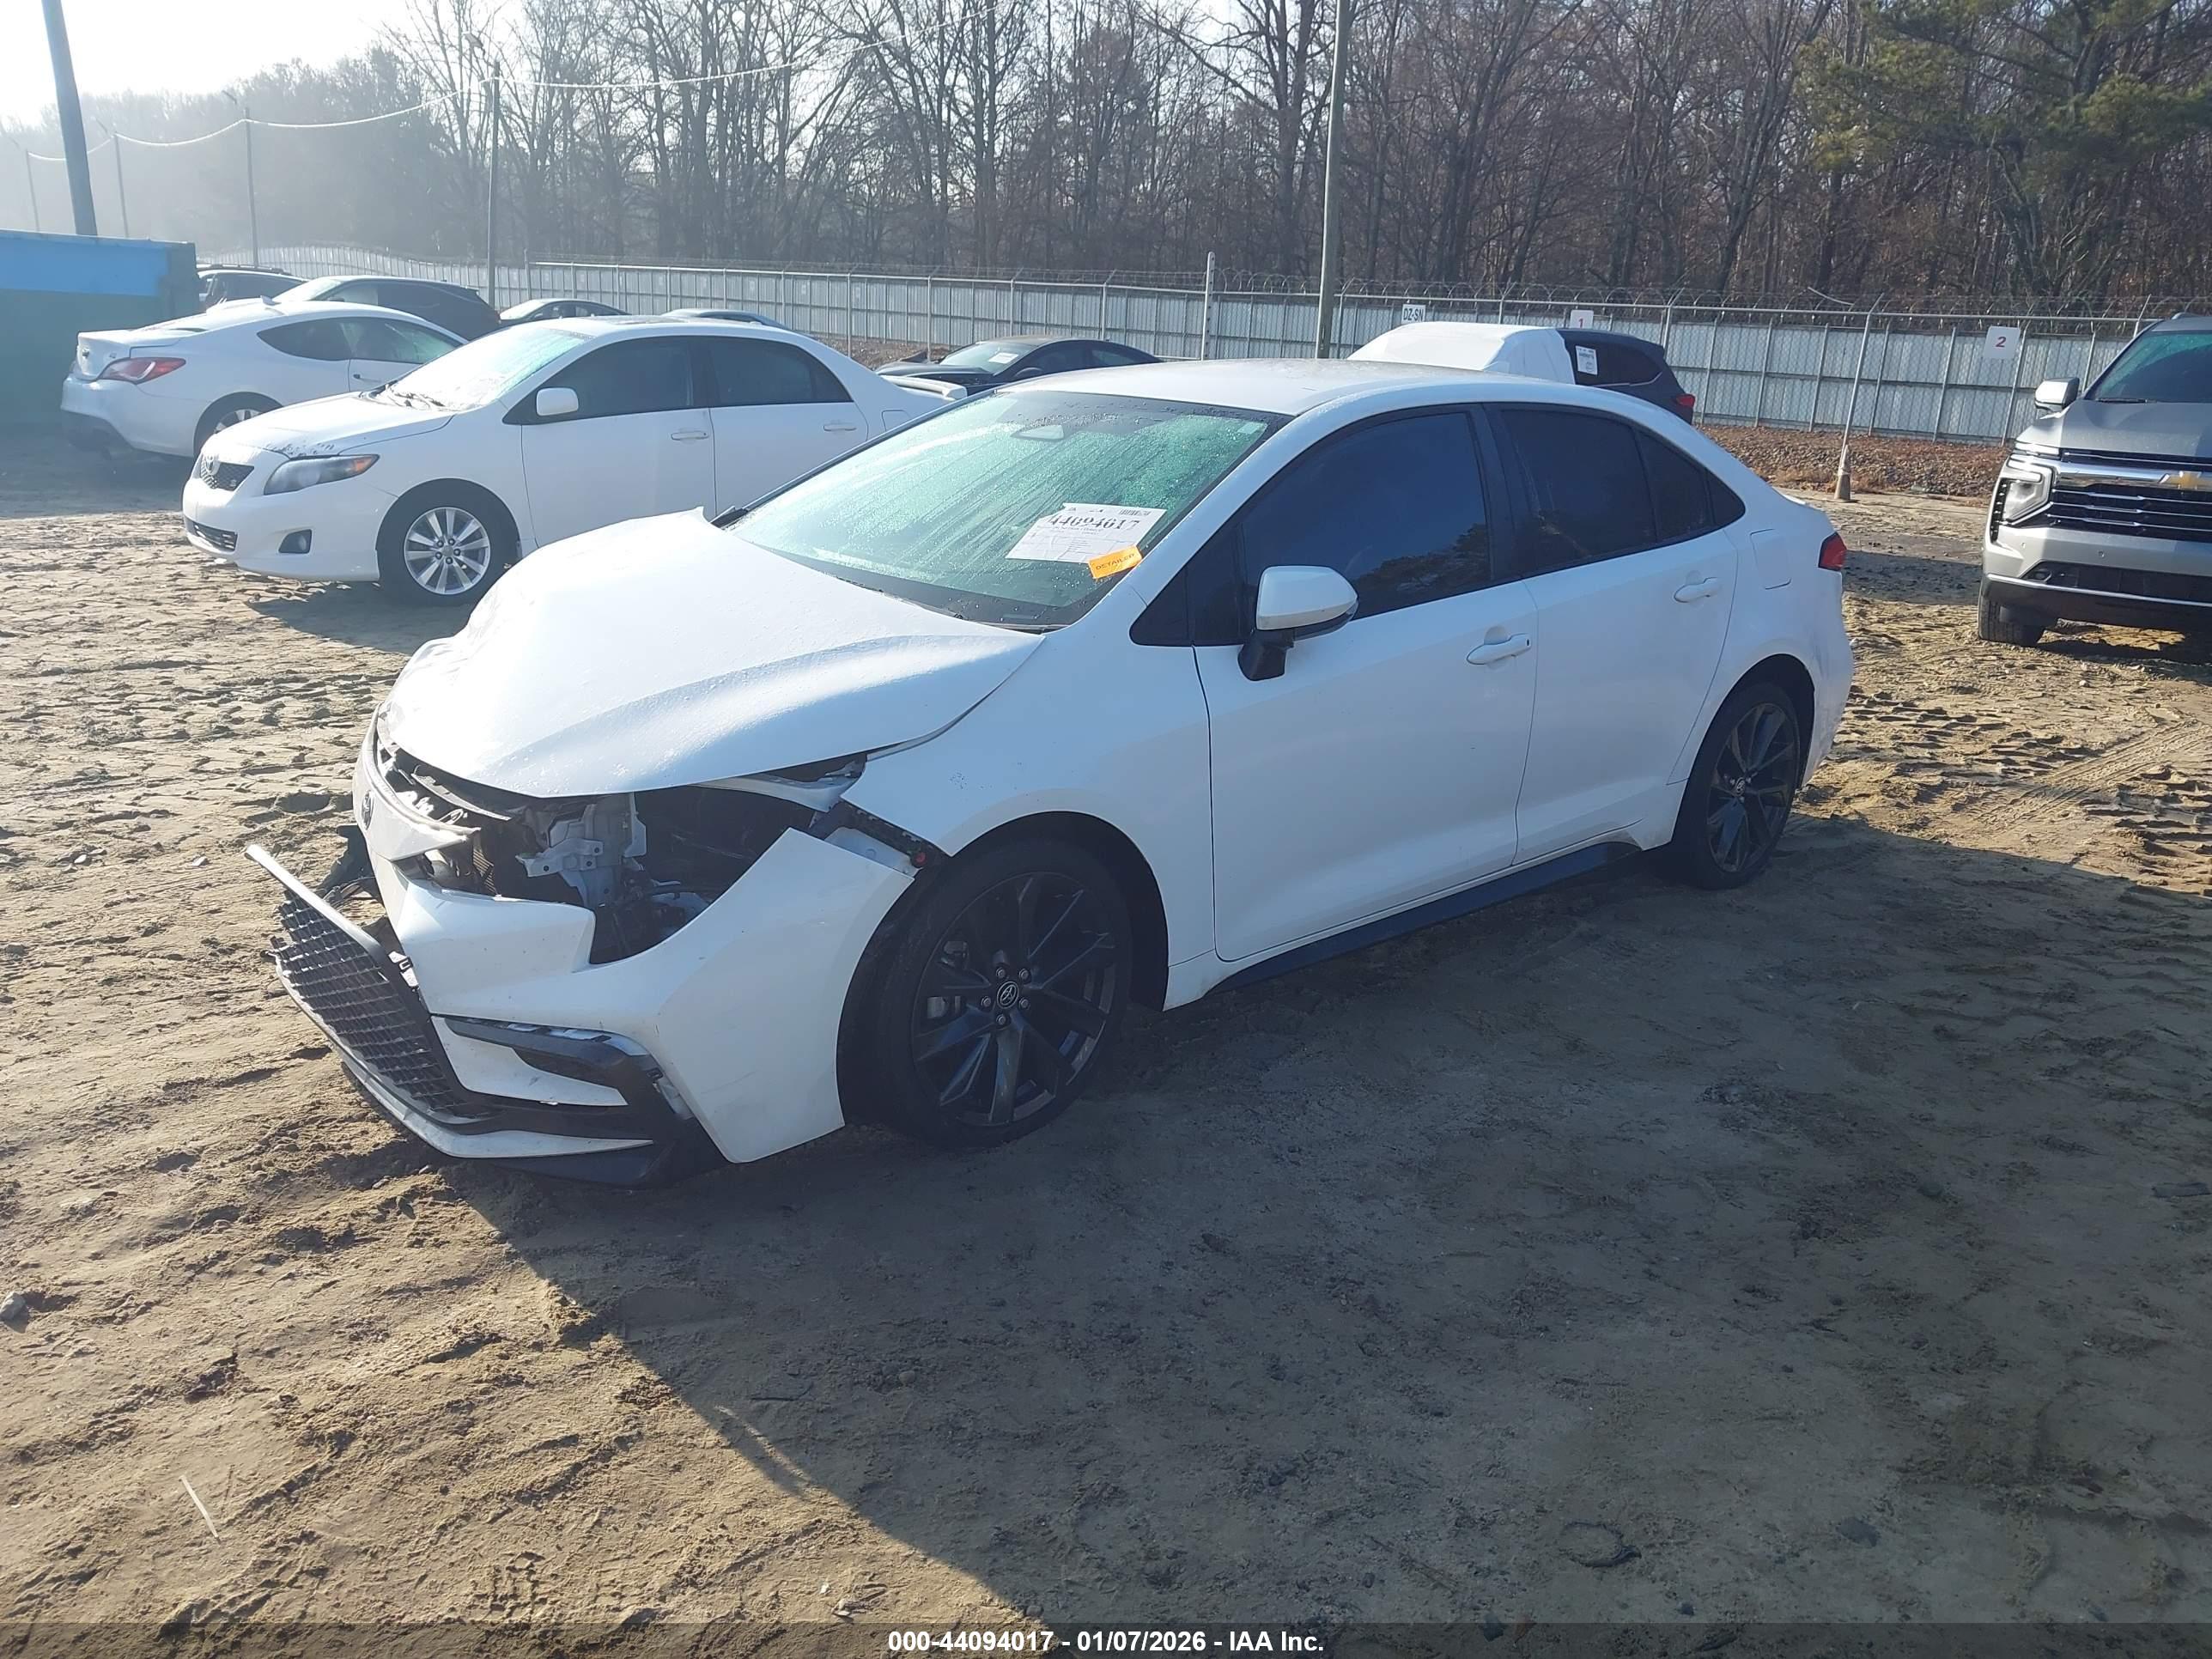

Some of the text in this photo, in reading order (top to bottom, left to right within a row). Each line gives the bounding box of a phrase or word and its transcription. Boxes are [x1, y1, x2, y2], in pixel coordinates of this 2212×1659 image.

[1403, 307, 1425, 322] DZ-SN
[1578, 318, 1584, 329] 1
[1995, 336, 2007, 348] 2
